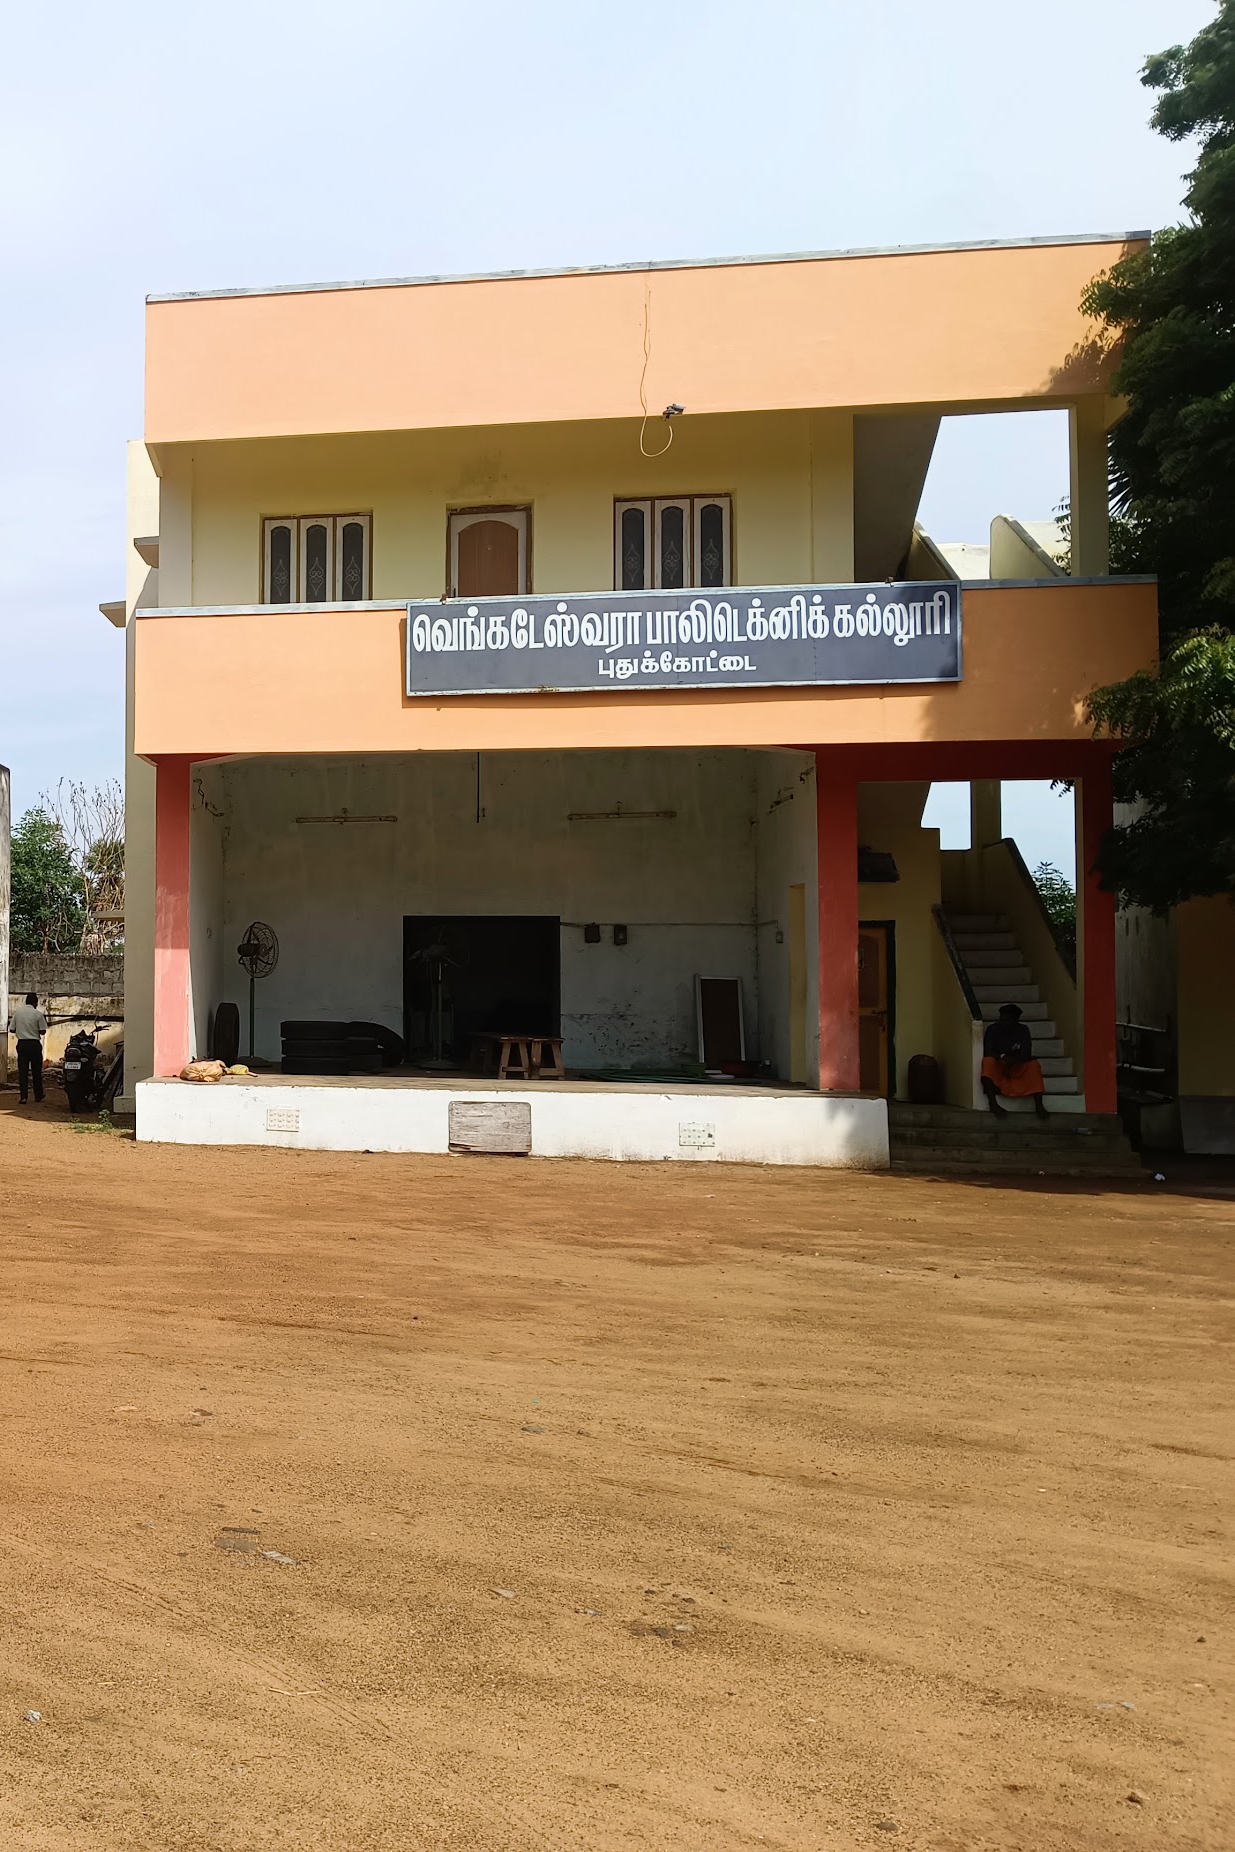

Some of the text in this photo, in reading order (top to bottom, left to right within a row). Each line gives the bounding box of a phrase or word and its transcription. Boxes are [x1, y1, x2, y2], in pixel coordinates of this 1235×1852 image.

[412, 591, 951, 654] வெங்கடேஸ்வரா பாலிடெக்னிக் கல்லூரி
[598, 649, 757, 679] புதுக்கோட்டை
